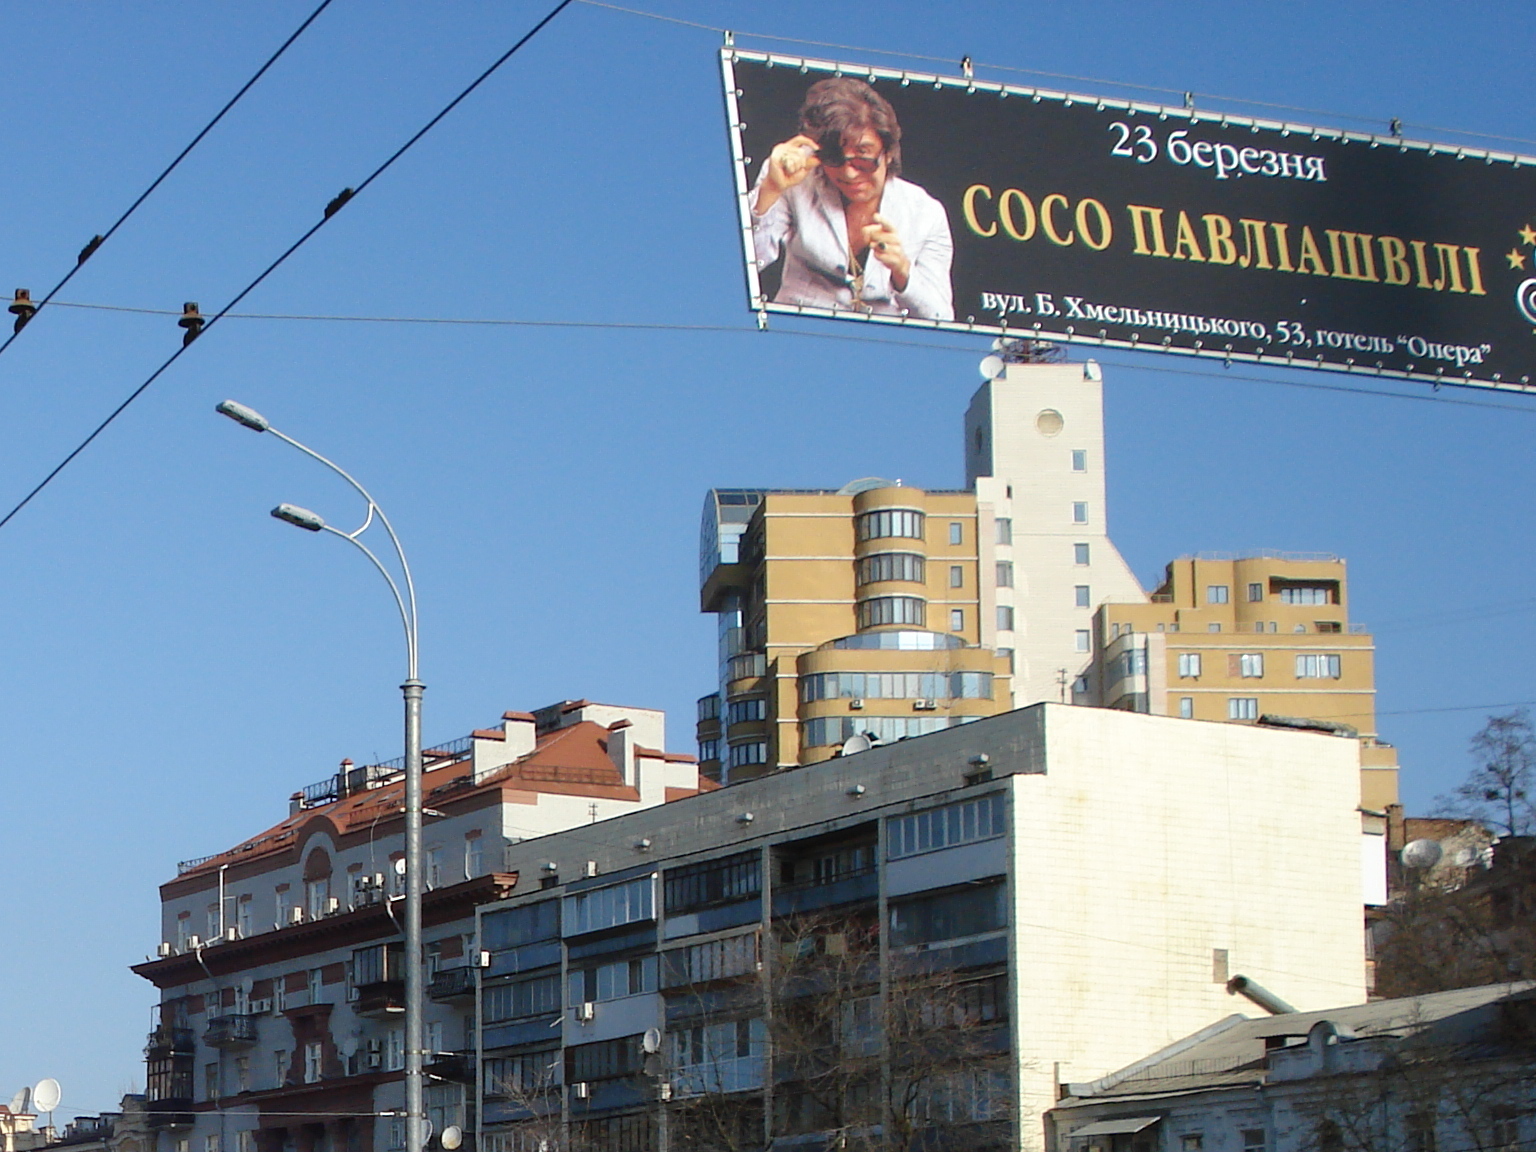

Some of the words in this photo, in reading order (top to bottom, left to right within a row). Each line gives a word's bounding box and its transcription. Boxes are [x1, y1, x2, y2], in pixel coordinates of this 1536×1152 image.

[1108, 121, 1158, 164] 23
[1167, 130, 1327, 182] березня
[962, 184, 1113, 250] СОСО
[1126, 204, 1487, 295] ПАВЛІАШВІЛІ
[981, 291, 1032, 317] вул.
[1035, 292, 1061, 316] Б.
[1064, 295, 1272, 345] Хмельницького,
[1276, 320, 1313, 348] 53,
[1316, 329, 1394, 354] готель
